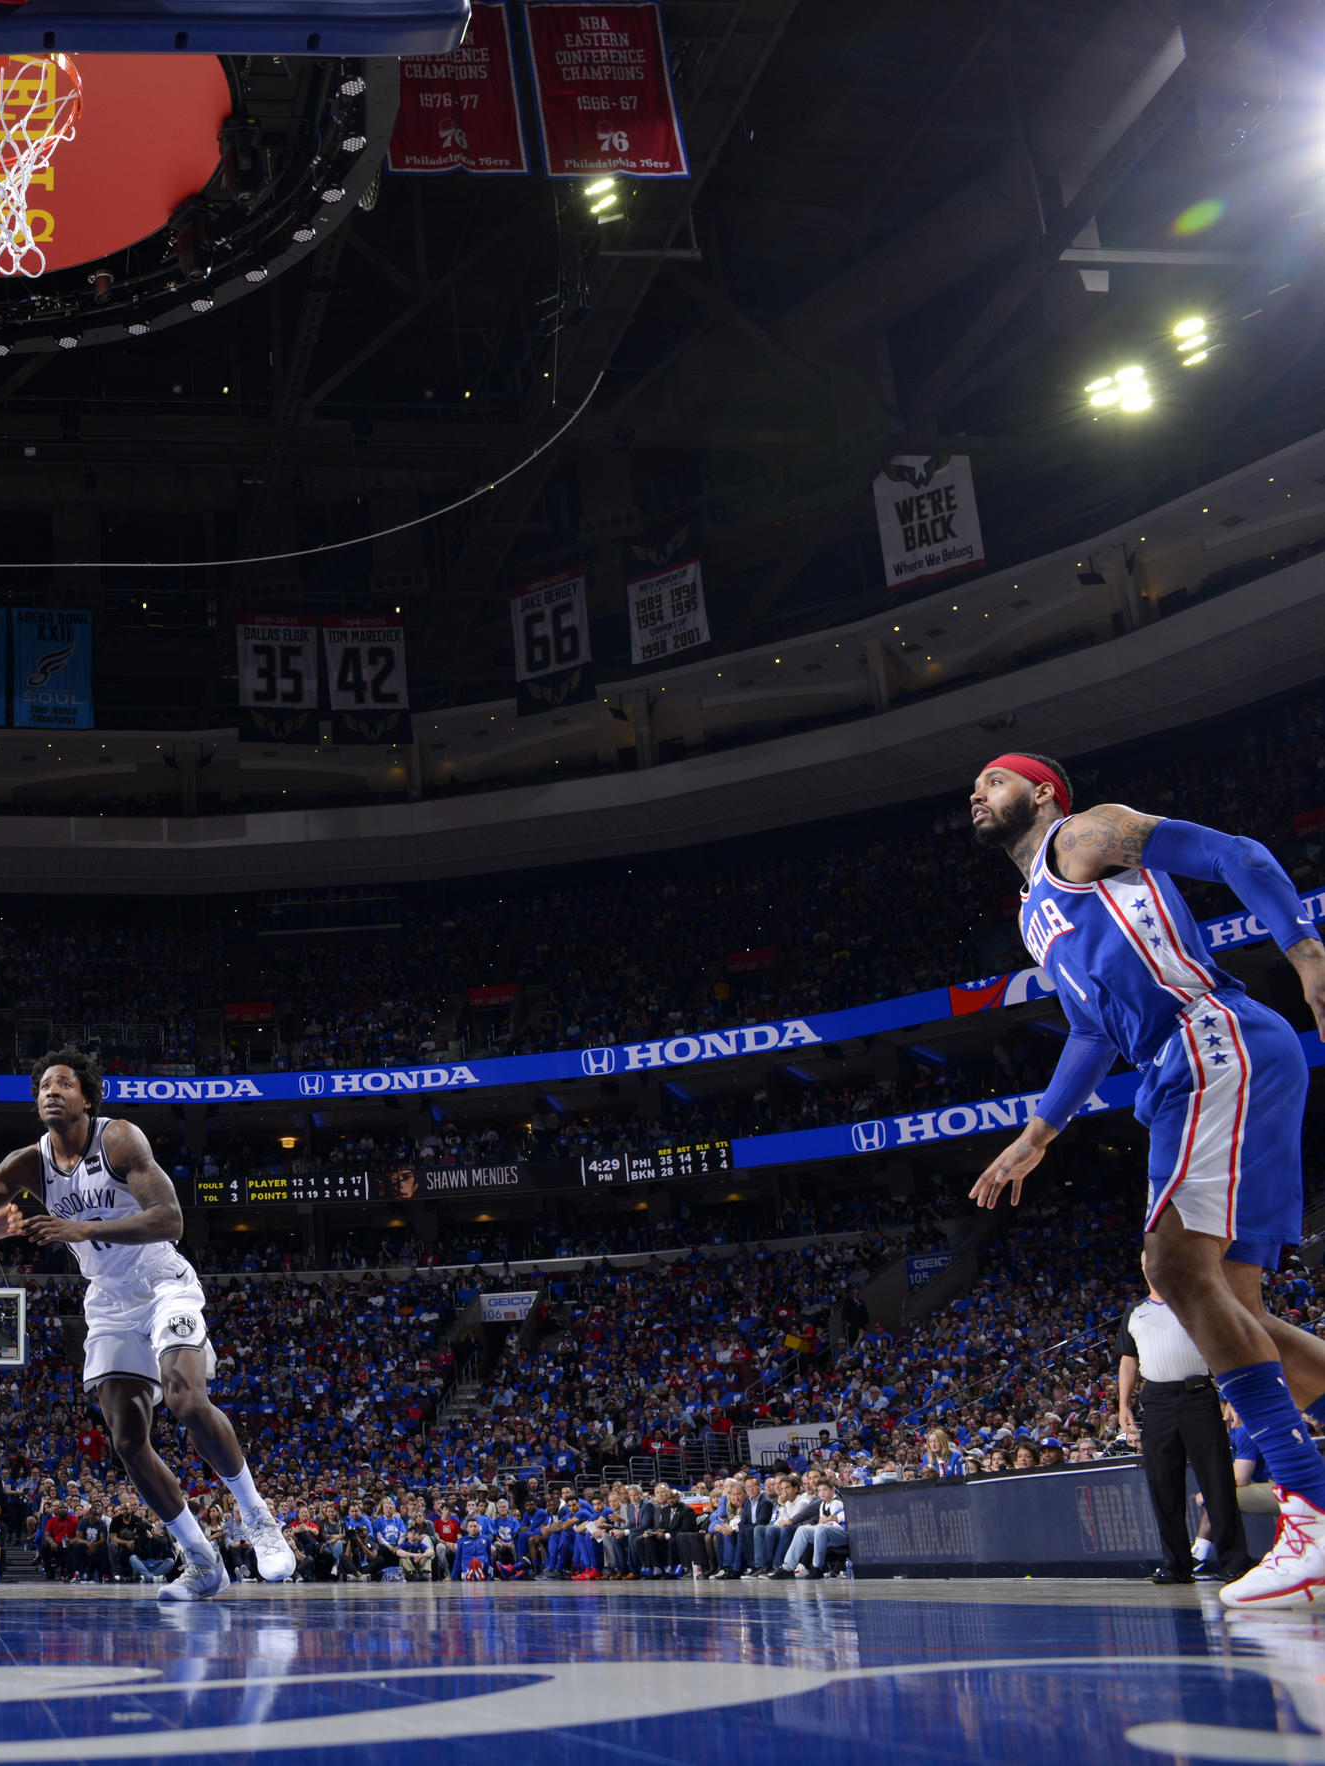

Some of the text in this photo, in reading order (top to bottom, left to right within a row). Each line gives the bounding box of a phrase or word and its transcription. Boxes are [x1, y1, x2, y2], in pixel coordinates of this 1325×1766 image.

[578, 16, 611, 31] NBA
[564, 32, 629, 48] EASTERN
[555, 48, 646, 65] CONFERENCE
[404, 63, 488, 80] CHAMPIONS
[562, 65, 645, 81] CHAMPIONS
[419, 92, 480, 110] 1976-77
[577, 95, 638, 111] 1966-67
[438, 128, 469, 150] 76
[596, 131, 630, 152] 76
[405, 154, 510, 166] Philadelphia 76ers
[564, 158, 671, 169] Philadelphia 76ers
[902, 513, 958, 553] BACK
[893, 545, 974, 577] Where We Belong
[520, 593, 542, 613] JAKE
[634, 594, 663, 615] 1989
[670, 581, 697, 603] 1990
[17, 611, 91, 625] ARENA BOWL
[636, 609, 664, 630] 1994
[244, 627, 280, 641] DALLAS
[328, 630, 348, 643] TOM
[523, 601, 580, 673] 66
[674, 627, 700, 649] 2001
[252, 644, 304, 704] 35
[336, 646, 400, 704] 42
[23, 691, 84, 704] SOUL
[624, 1019, 822, 1071] HONDA
[331, 1065, 479, 1093] HONDA
[117, 1079, 263, 1099] HONDA
[632, 1158, 652, 1168] PHI
[660, 1148, 726, 1165] 35 14 7 3
[588, 1159, 620, 1172] 4:29
[631, 1160, 728, 1181] BKN 28 11 2 4
[230, 1180, 238, 1190] 4
[248, 1176, 362, 1188] PLAYER 12 1 6 8 17
[426, 1165, 518, 1190] SHAWN MENDES
[598, 1173, 613, 1182] PM
[231, 1193, 238, 1202] 3
[250, 1189, 360, 1201] POINTS 11 19 2 11 6
[488, 1296, 532, 1307] GEICO
[169, 1315, 196, 1330] NETS
[483, 1310, 502, 1320] 106
